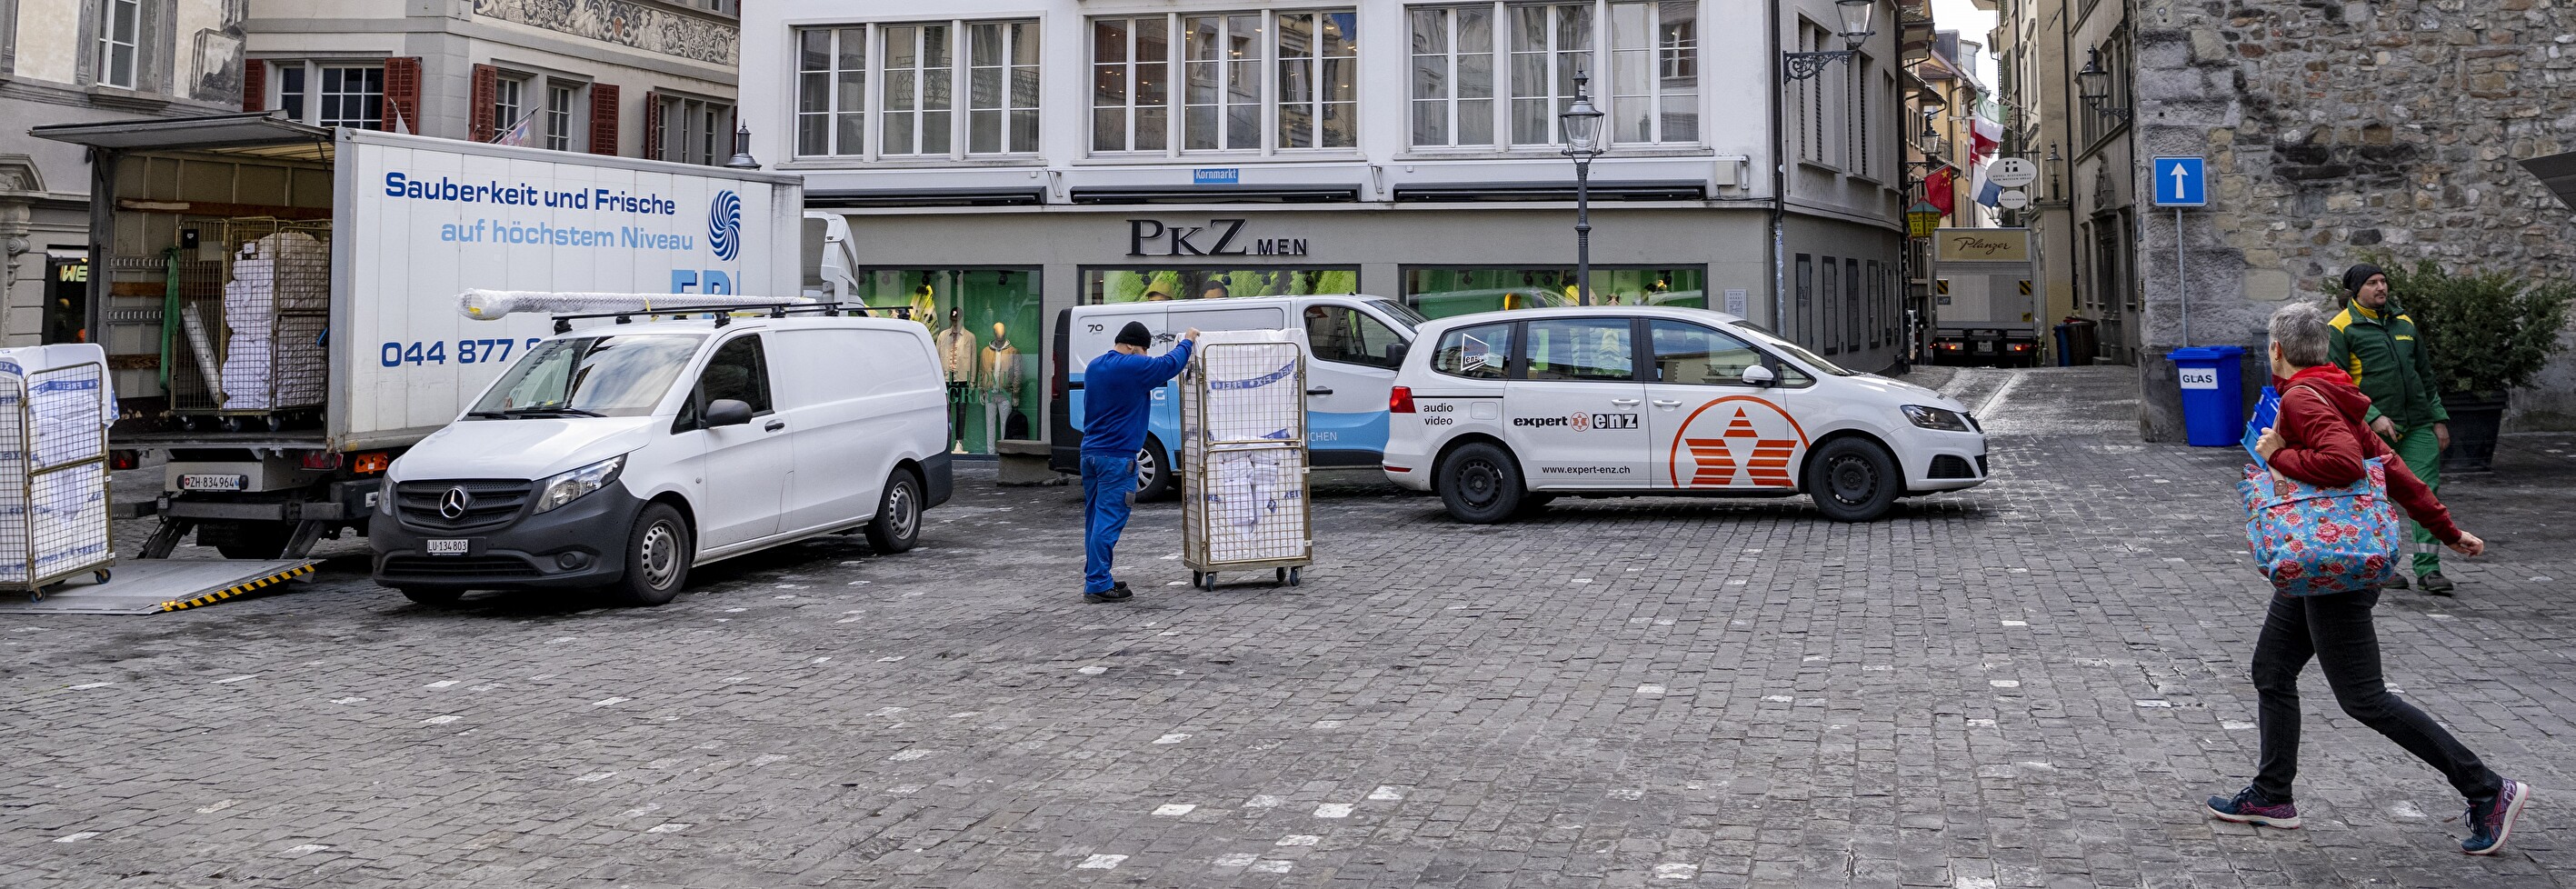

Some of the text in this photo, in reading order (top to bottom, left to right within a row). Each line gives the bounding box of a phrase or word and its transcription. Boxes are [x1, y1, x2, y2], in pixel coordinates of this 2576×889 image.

[1195, 168, 1236, 179] Kornmarkt
[385, 172, 675, 215] Sauberkeit und Frische
[441, 219, 694, 251] auf höchstem Niveau
[1125, 218, 1307, 256] PKZ MEN
[1953, 236, 2012, 255] Planzer
[1087, 324, 1103, 334] 70
[381, 341, 446, 367] 044
[457, 338, 514, 364] 877
[2182, 375, 2212, 384] GLAS
[1423, 403, 1453, 413] audio
[1424, 415, 1453, 425] video
[1513, 414, 1639, 430] expert enz
[1542, 466, 1631, 474] www.expert-enz.ch
